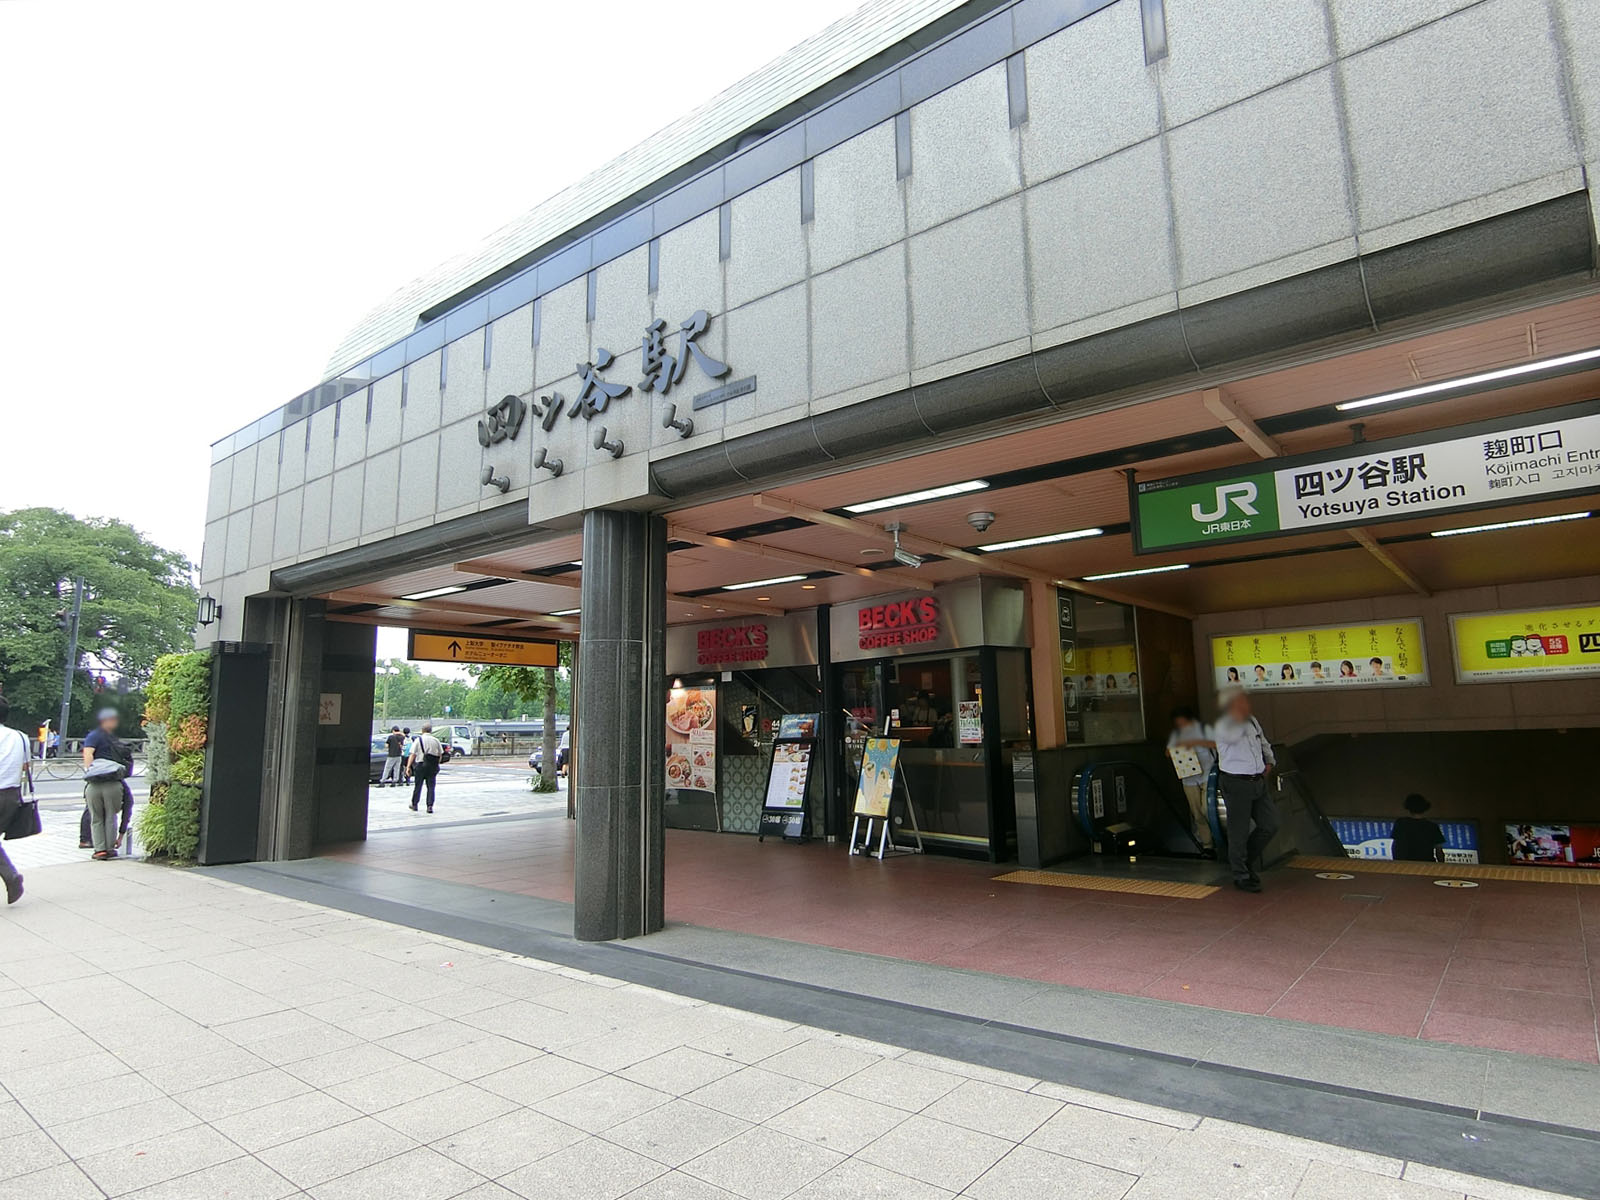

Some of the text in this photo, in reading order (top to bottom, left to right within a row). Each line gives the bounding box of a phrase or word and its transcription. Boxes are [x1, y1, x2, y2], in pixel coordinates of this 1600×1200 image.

[478, 309, 732, 448] 四ツ谷駅
[1483, 430, 1563, 460] 麹町口
[1294, 453, 1427, 500] 四ツ谷駅
[1191, 481, 1259, 523] JR
[1298, 482, 1466, 520] Yotsuya Station
[1202, 519, 1252, 535] JR東日本
[859, 596, 937, 630] BECK'S
[697, 624, 768, 648] BECK'S
[859, 627, 937, 650] COFFEE SHOP
[697, 647, 768, 665] COFFEE SHOP
